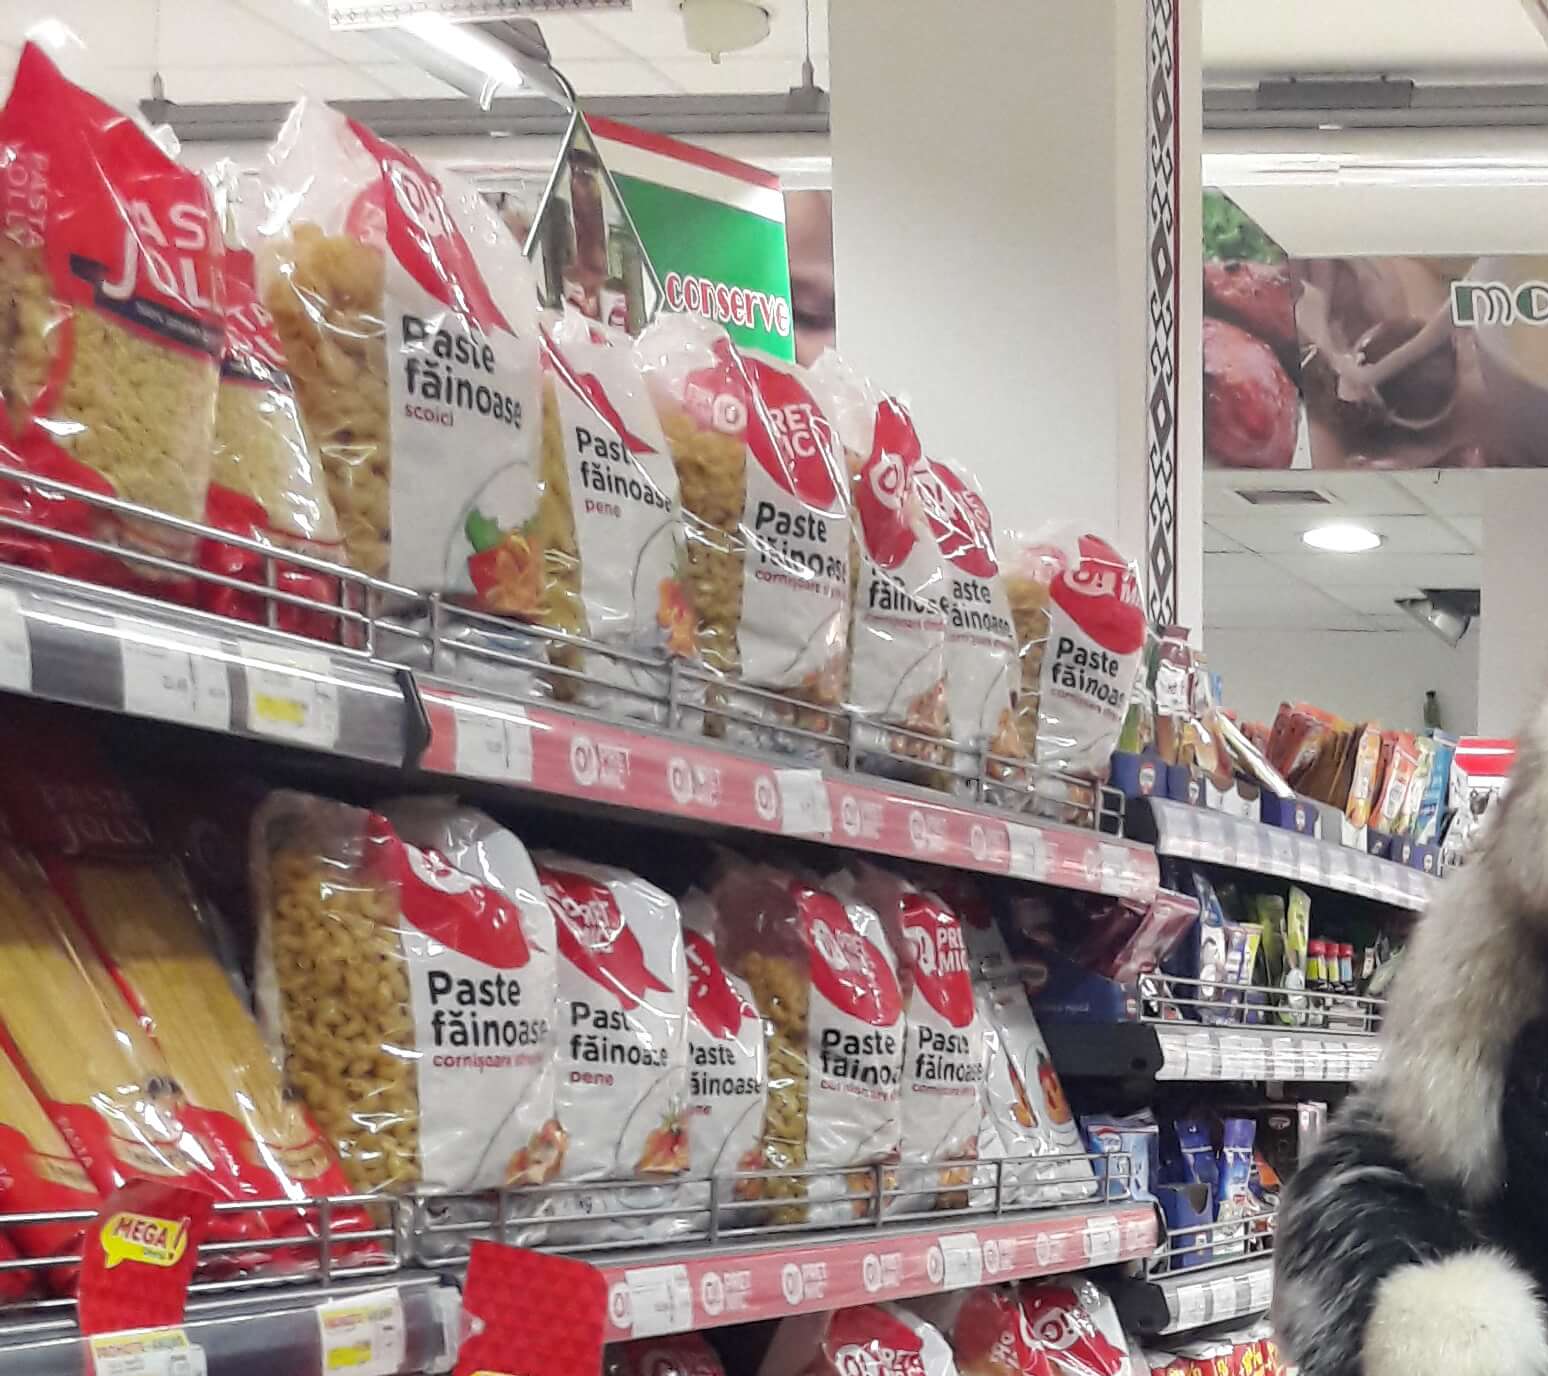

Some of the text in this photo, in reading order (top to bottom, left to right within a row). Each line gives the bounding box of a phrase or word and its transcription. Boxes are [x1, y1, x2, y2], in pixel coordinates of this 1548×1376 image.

[664, 271, 793, 337] conserve
[576, 425, 634, 467] Past
[755, 500, 828, 543] Paste
[952, 577, 992, 603] aste
[951, 604, 1012, 638] ăinoase
[1056, 636, 1120, 677] Paste
[426, 970, 521, 1007] Paste
[432, 1009, 549, 1048] făinoase
[570, 1001, 632, 1033] Past
[689, 1042, 737, 1068] aste
[820, 1027, 896, 1056] Paste
[570, 1070, 614, 1087] pene
[690, 1069, 762, 1097] ăinoase
